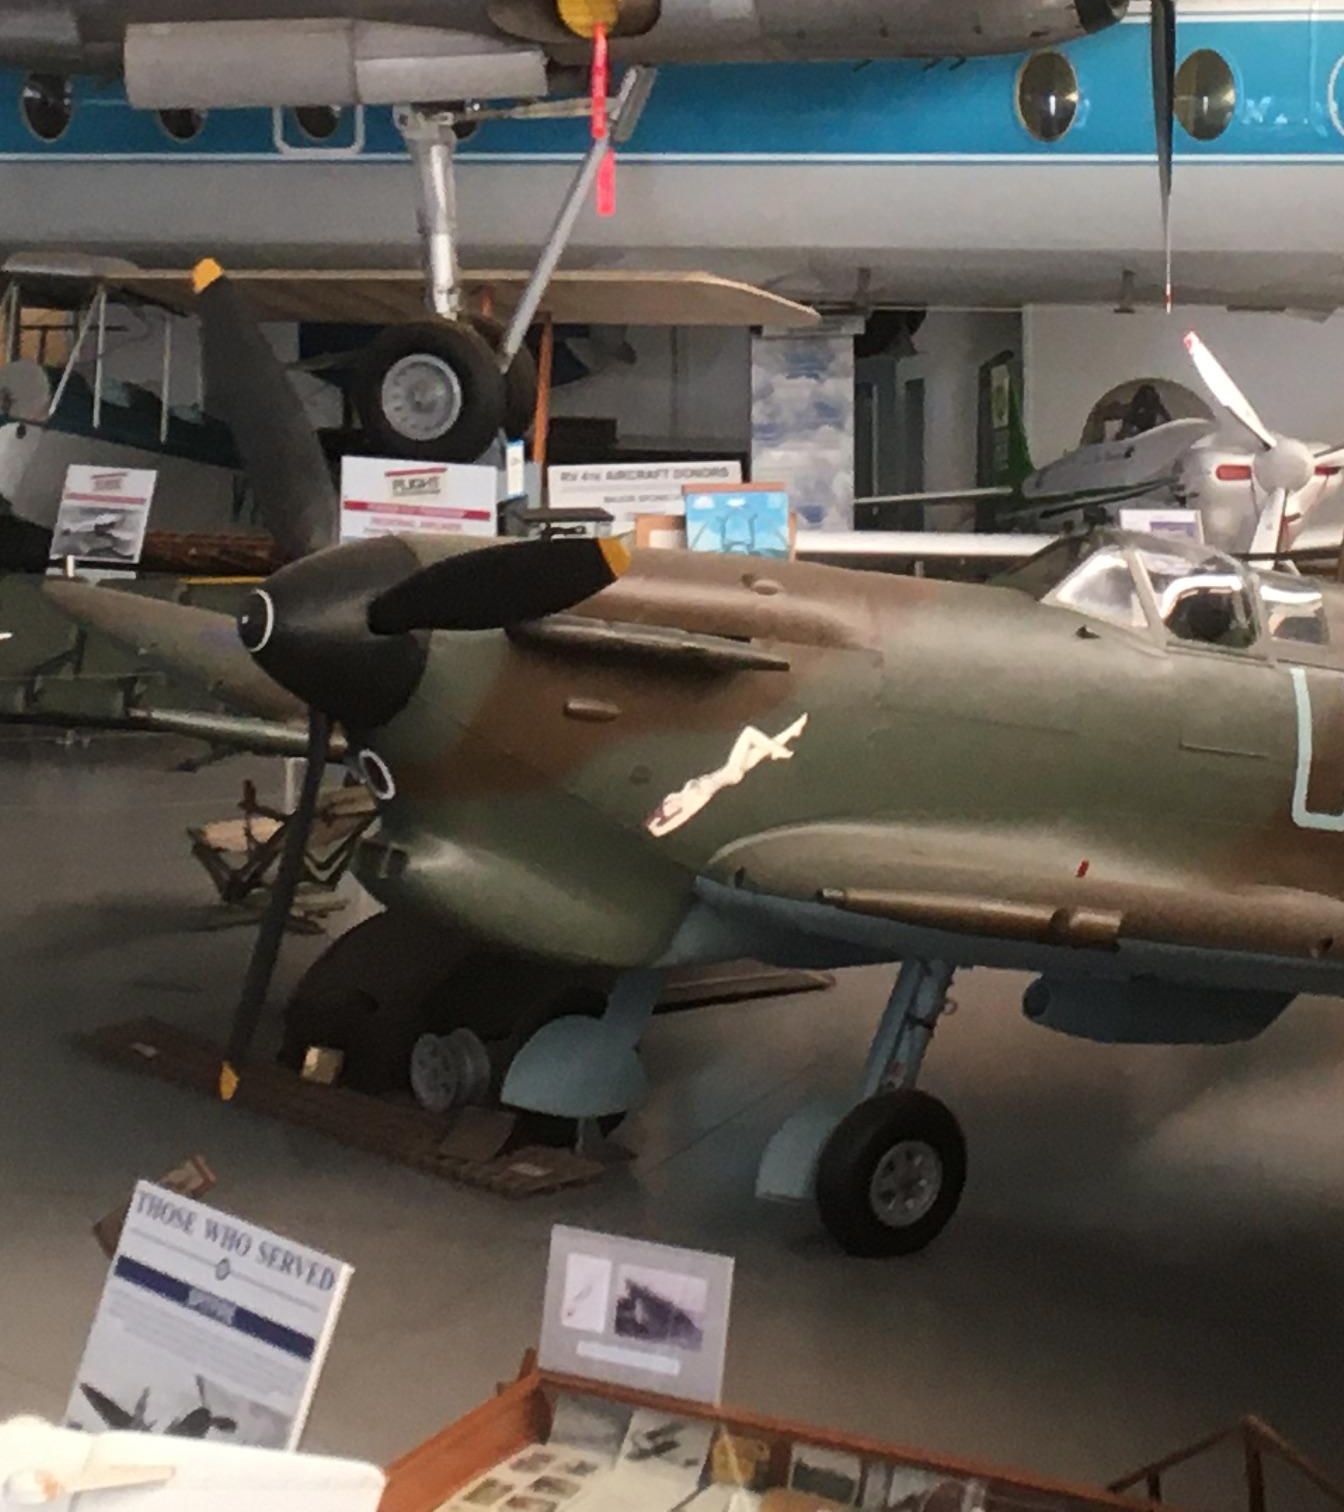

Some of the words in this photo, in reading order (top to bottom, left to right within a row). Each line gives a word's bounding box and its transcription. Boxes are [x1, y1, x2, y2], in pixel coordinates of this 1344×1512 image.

[135, 1190, 197, 1235] THOSE
[205, 1218, 253, 1257] WHO
[258, 1239, 338, 1292] SERVED
